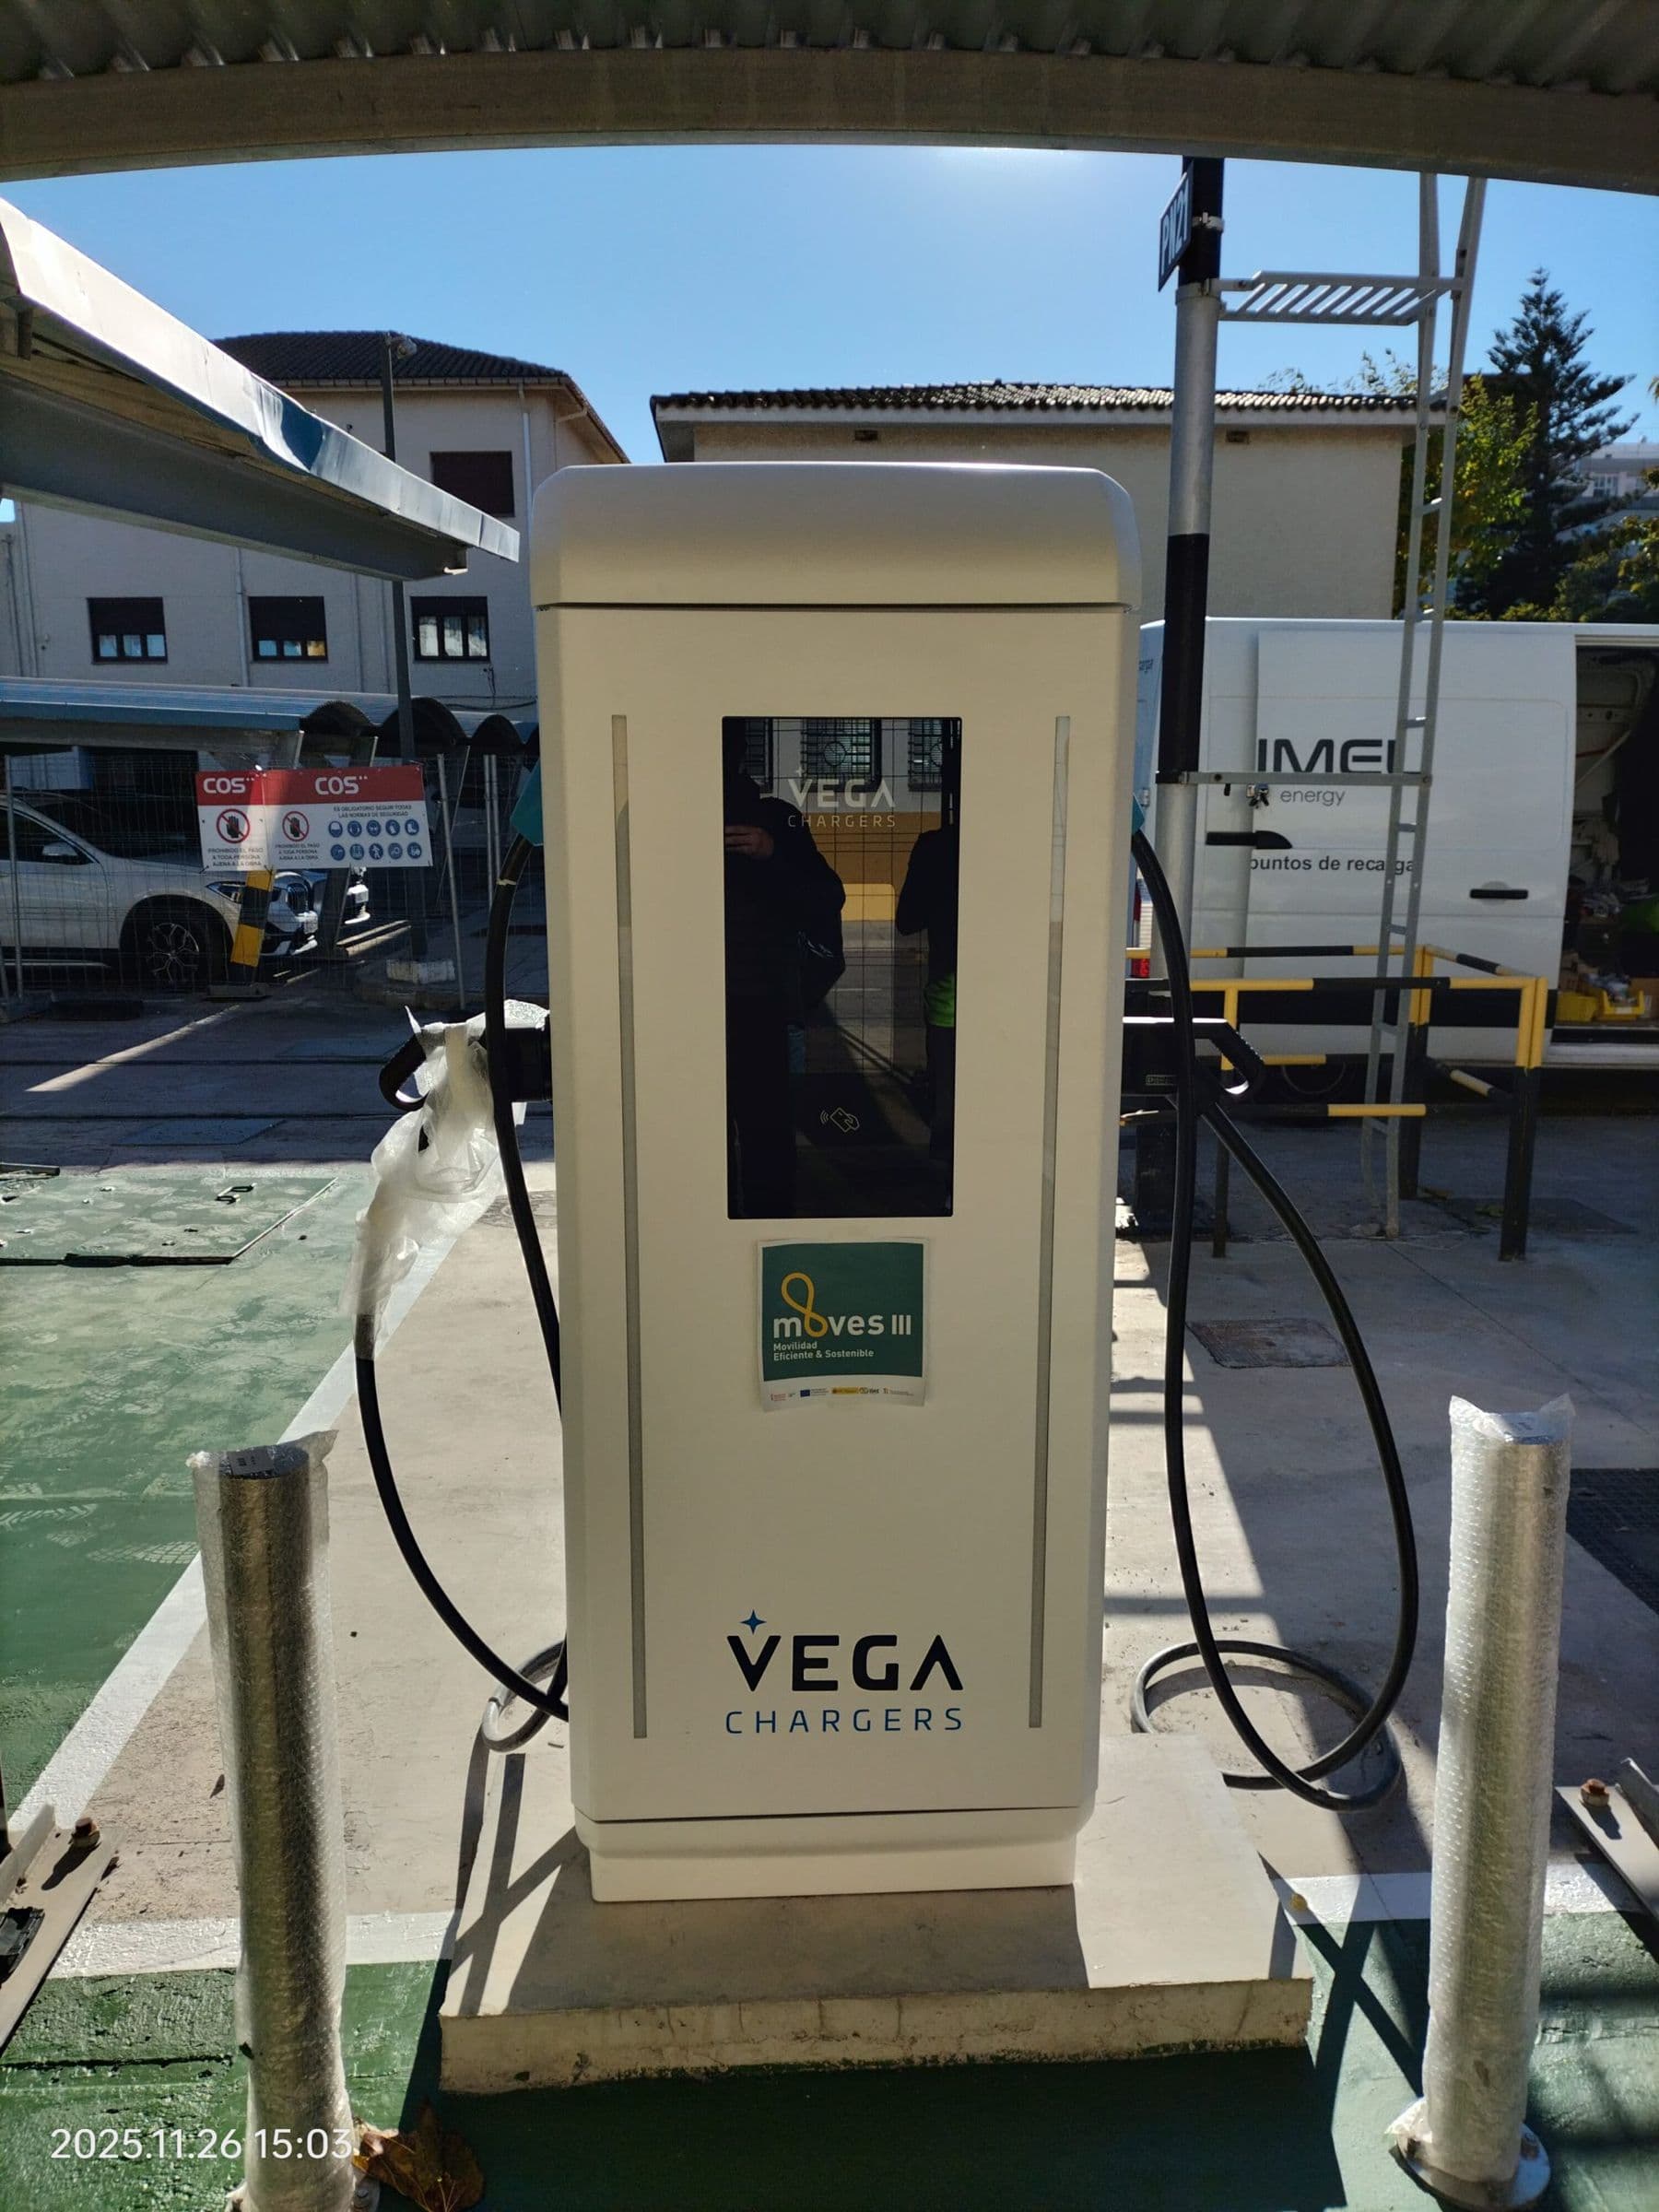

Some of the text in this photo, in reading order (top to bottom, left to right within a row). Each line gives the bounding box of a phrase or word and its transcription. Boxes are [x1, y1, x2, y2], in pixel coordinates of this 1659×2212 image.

[203, 777, 246, 794] COS
[314, 776, 359, 795] COS
[787, 778, 897, 808] VEGA
[1280, 789, 1346, 806] energy
[788, 815, 897, 828] CHARGERS
[1318, 855, 1341, 871] de
[1347, 858, 1414, 876] recaga
[891, 1314, 912, 1335] III
[773, 1341, 818, 1351] Movilidad
[773, 1348, 875, 1361] Eficiente & Sostenible
[726, 1634, 964, 1692] VEGA
[725, 1708, 962, 1734] CHARGERS
